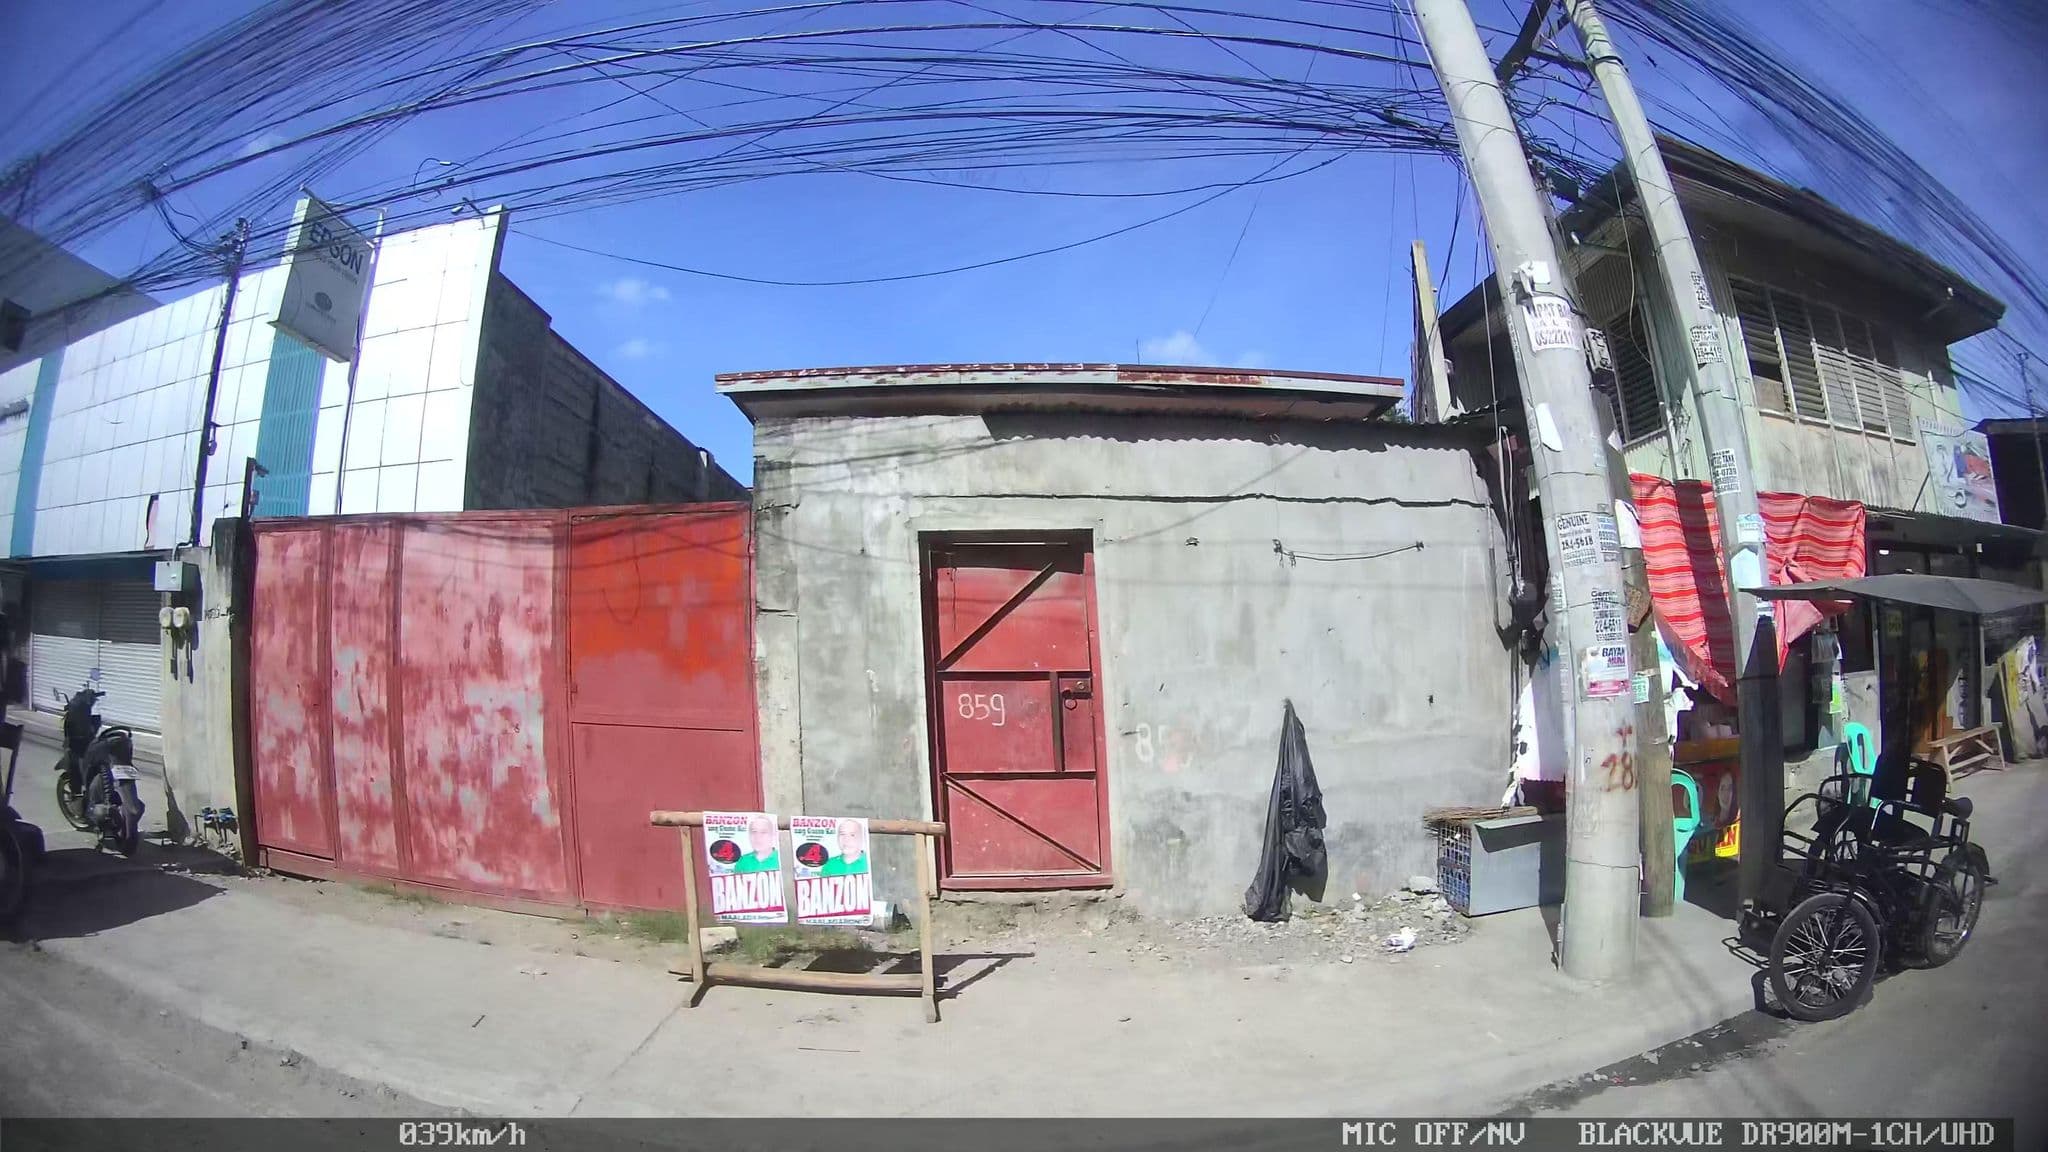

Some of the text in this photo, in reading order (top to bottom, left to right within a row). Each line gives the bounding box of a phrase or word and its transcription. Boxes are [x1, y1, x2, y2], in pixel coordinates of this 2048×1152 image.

[1556, 513, 1591, 531] GENUINE
[957, 692, 1006, 727] 859
[705, 815, 748, 825] BANZON
[792, 818, 837, 829] BANZON
[711, 870, 784, 914] BANZON
[796, 874, 871, 918] BANZON
